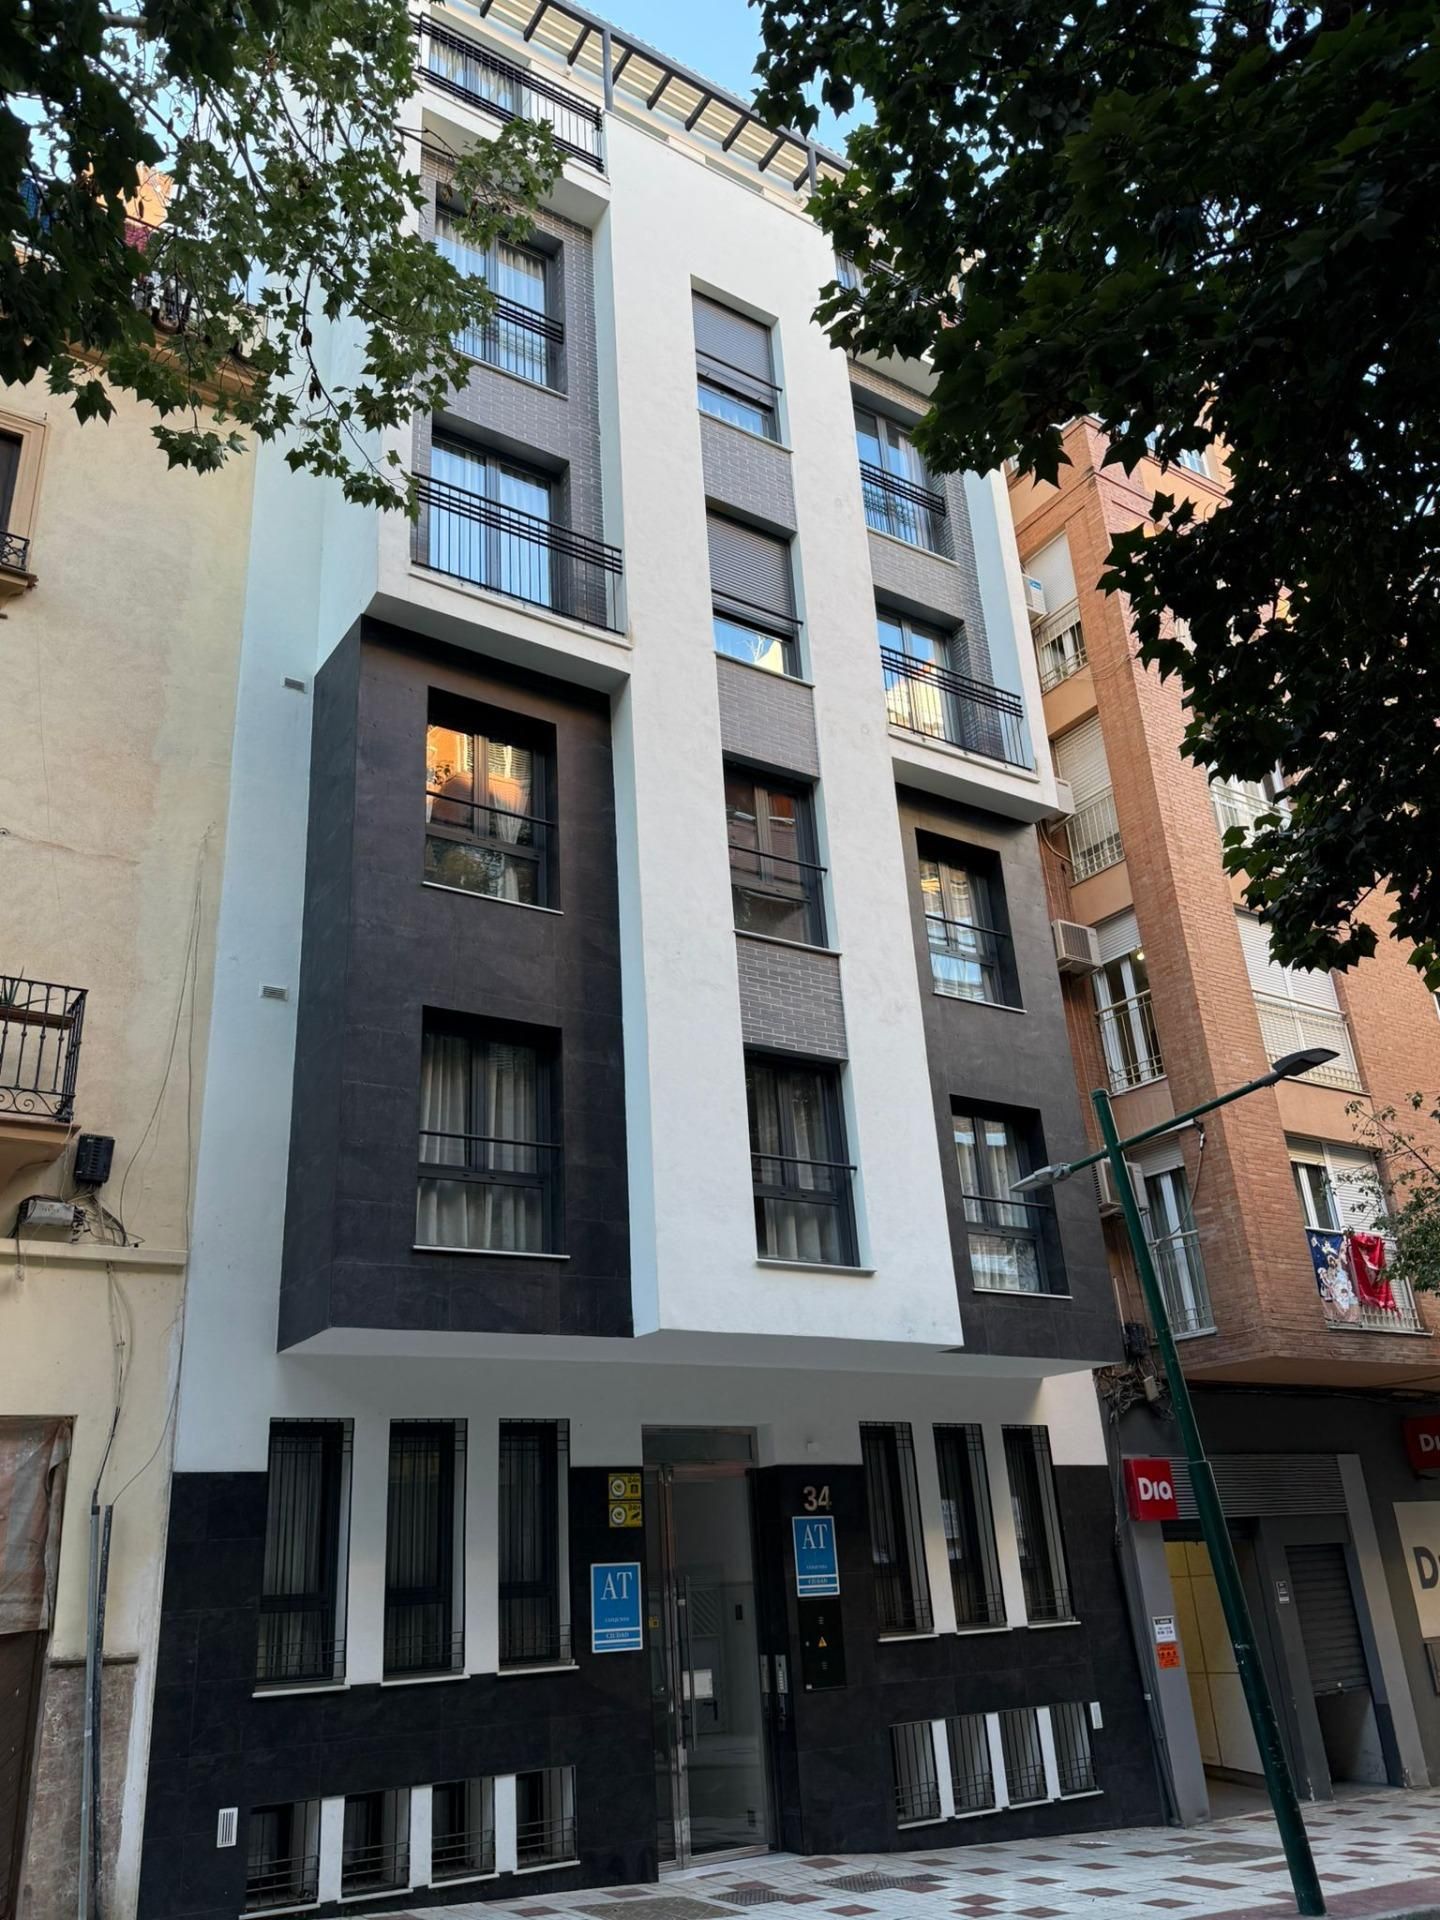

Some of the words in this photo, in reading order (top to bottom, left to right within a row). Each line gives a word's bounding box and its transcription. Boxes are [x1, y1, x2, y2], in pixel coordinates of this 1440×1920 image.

[803, 1485, 832, 1512] 34
[1137, 1477, 1173, 1500] Dia
[801, 1523, 828, 1550] AT
[1413, 1546, 1440, 1590] D
[600, 1571, 633, 1600] AT
